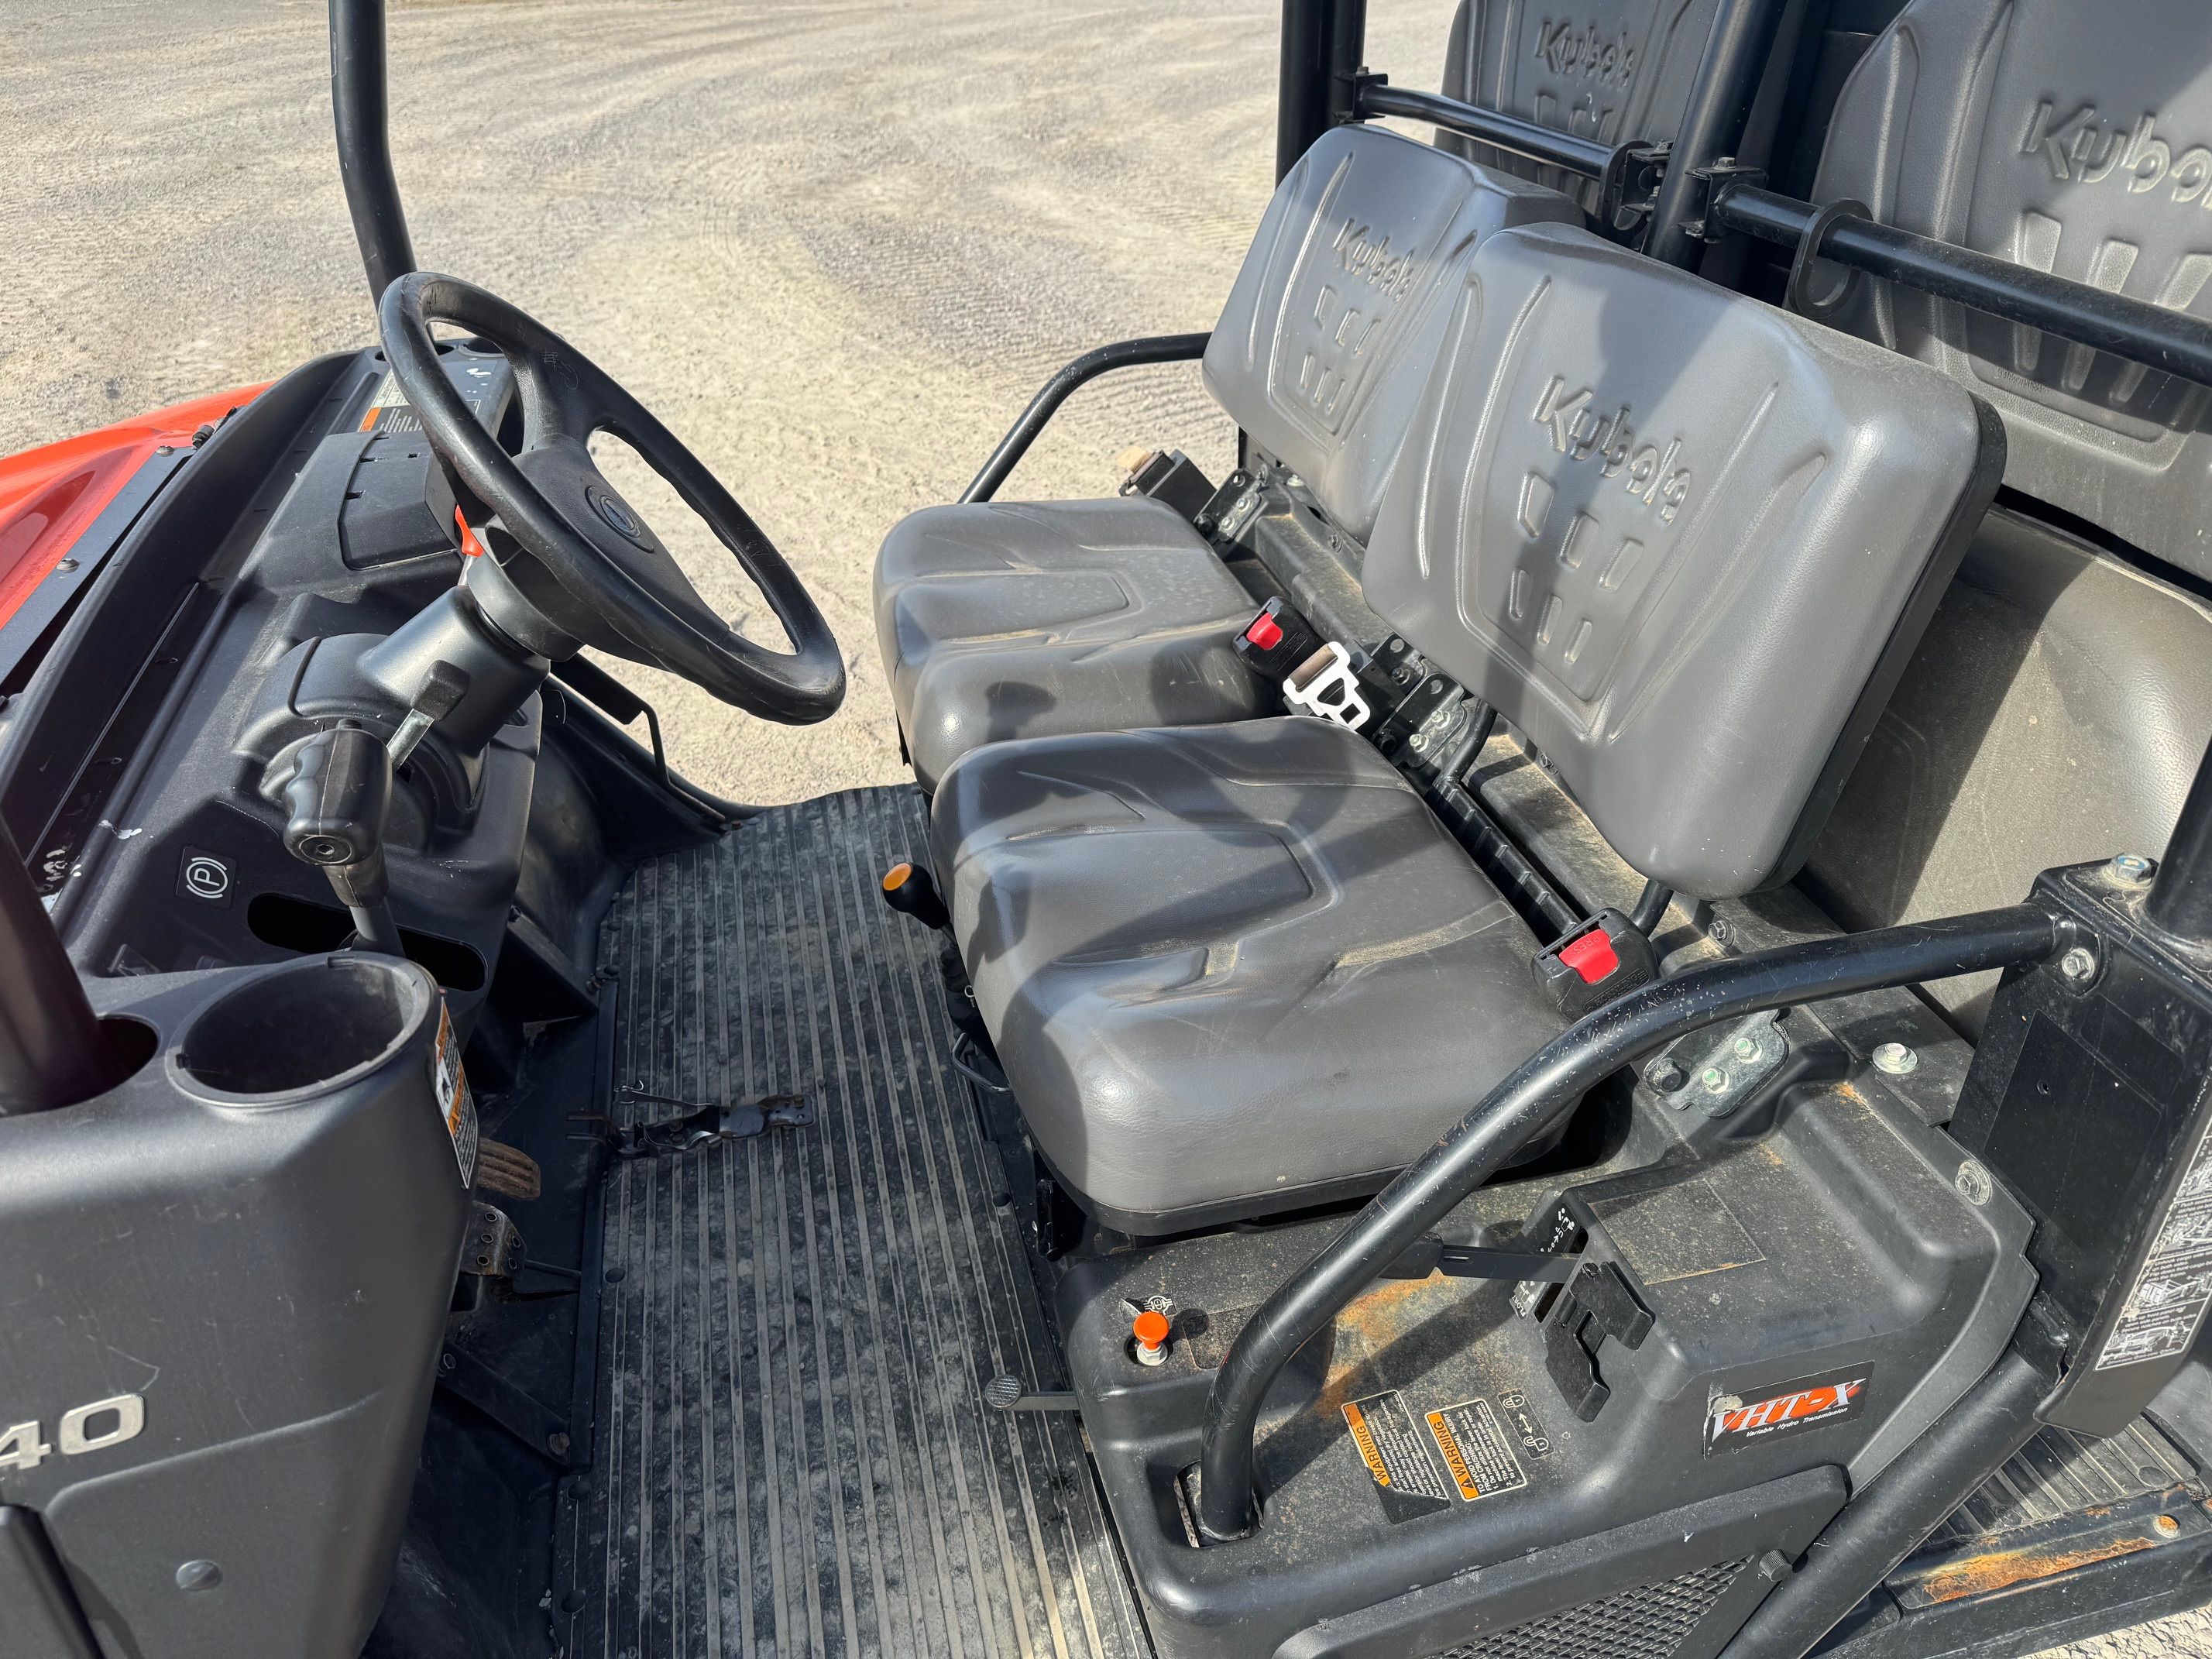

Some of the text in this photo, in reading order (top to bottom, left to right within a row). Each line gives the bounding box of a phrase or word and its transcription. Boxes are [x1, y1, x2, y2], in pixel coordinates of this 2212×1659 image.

[2018, 99, 2212, 211] Kubo
[1531, 376, 1691, 526] Kubota
[1511, 1295, 1527, 1317] FLOAT
[1457, 1410, 1465, 1419] for
[1712, 1379, 1867, 1443] VHT-X
[0, 1394, 145, 1470] 40
[1441, 1412, 1457, 1434] INJURY
[1460, 1418, 1470, 1430] lock
[1745, 1407, 1849, 1437] Variable Hydro Transmission
[1373, 1434, 1383, 1446] may
[1391, 1427, 1401, 1440] local
[1465, 1429, 1476, 1442] lever
[1486, 1427, 1503, 1453] accidental
[1355, 1424, 1387, 1480] WARNING
[1396, 1439, 1409, 1458] contact
[1431, 1420, 1468, 1477] WARNING
[1451, 1433, 1472, 1465] PERSONAL
[1472, 1428, 1492, 1460] maintenance
[1472, 1441, 1481, 1451] the
[1488, 1444, 1498, 1457] lock
[1378, 1445, 1395, 1472] equipment
[1386, 1448, 1400, 1467] around
[1398, 1457, 1408, 1469] may
[1404, 1457, 1417, 1475] should
[1409, 1451, 1427, 1479] regulations
[1463, 1440, 1493, 1491] FROM CRUSHING:
[1476, 1450, 1488, 1466] utilize
[1493, 1456, 1504, 1470] lever
[1498, 1451, 1513, 1472] prevent
[1389, 1471, 1398, 1482] this
[1420, 1461, 1438, 1488] prevention
[1467, 1464, 1482, 1483] AVOID
[1483, 1465, 1492, 1475] not
[1487, 1459, 1503, 1482] machine
[1499, 1468, 1510, 1480] The
[1400, 1477, 1409, 1489] start
